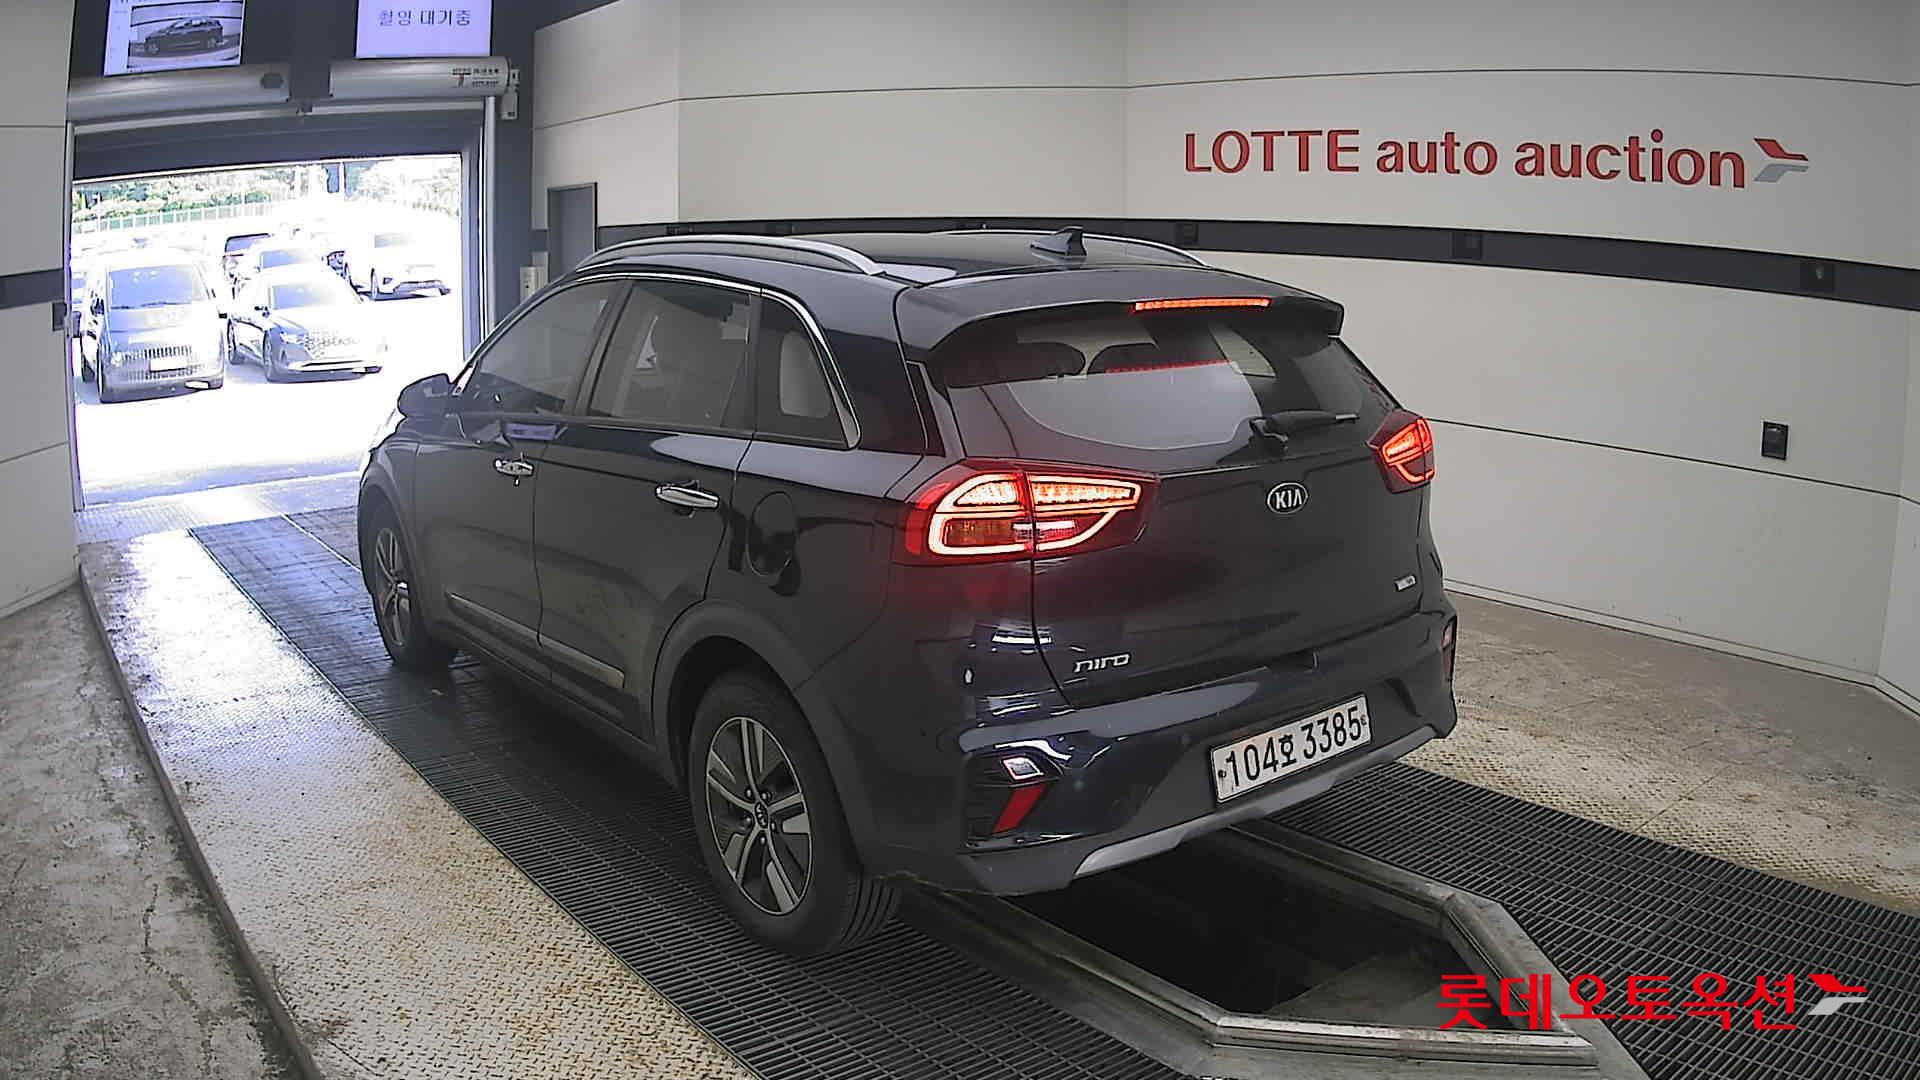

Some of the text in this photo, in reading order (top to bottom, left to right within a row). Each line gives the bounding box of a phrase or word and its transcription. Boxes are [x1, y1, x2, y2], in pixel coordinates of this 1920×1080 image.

[420, 9, 471, 27] 대기중
[1185, 129, 1745, 188] LOTTE auto auction
[1275, 488, 1302, 510] KIA
[1226, 706, 1362, 787] 104호 3385
